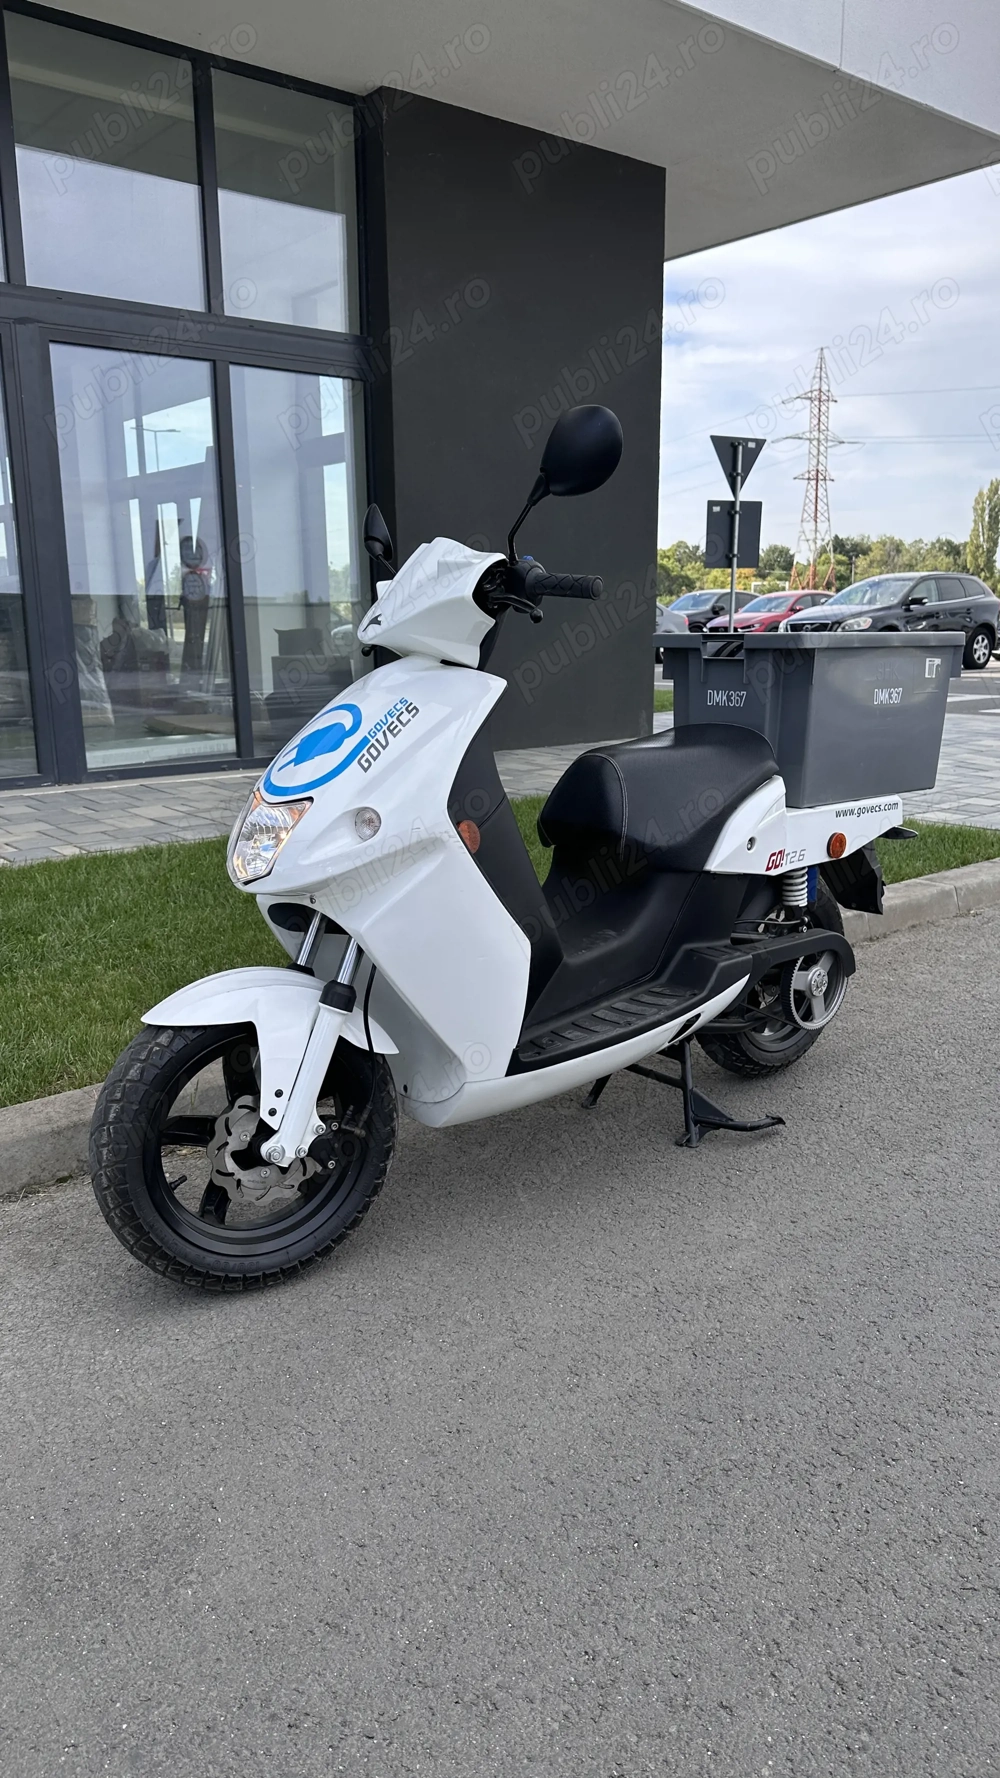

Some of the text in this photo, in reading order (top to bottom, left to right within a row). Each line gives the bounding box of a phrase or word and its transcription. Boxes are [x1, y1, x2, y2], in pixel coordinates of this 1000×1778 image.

[707, 689, 747, 707] DMK367
[874, 688, 903, 705] DMK367
[367, 697, 409, 739] GOVECS
[356, 701, 420, 773] GOVECS
[835, 802, 899, 818] www.govecs.com
